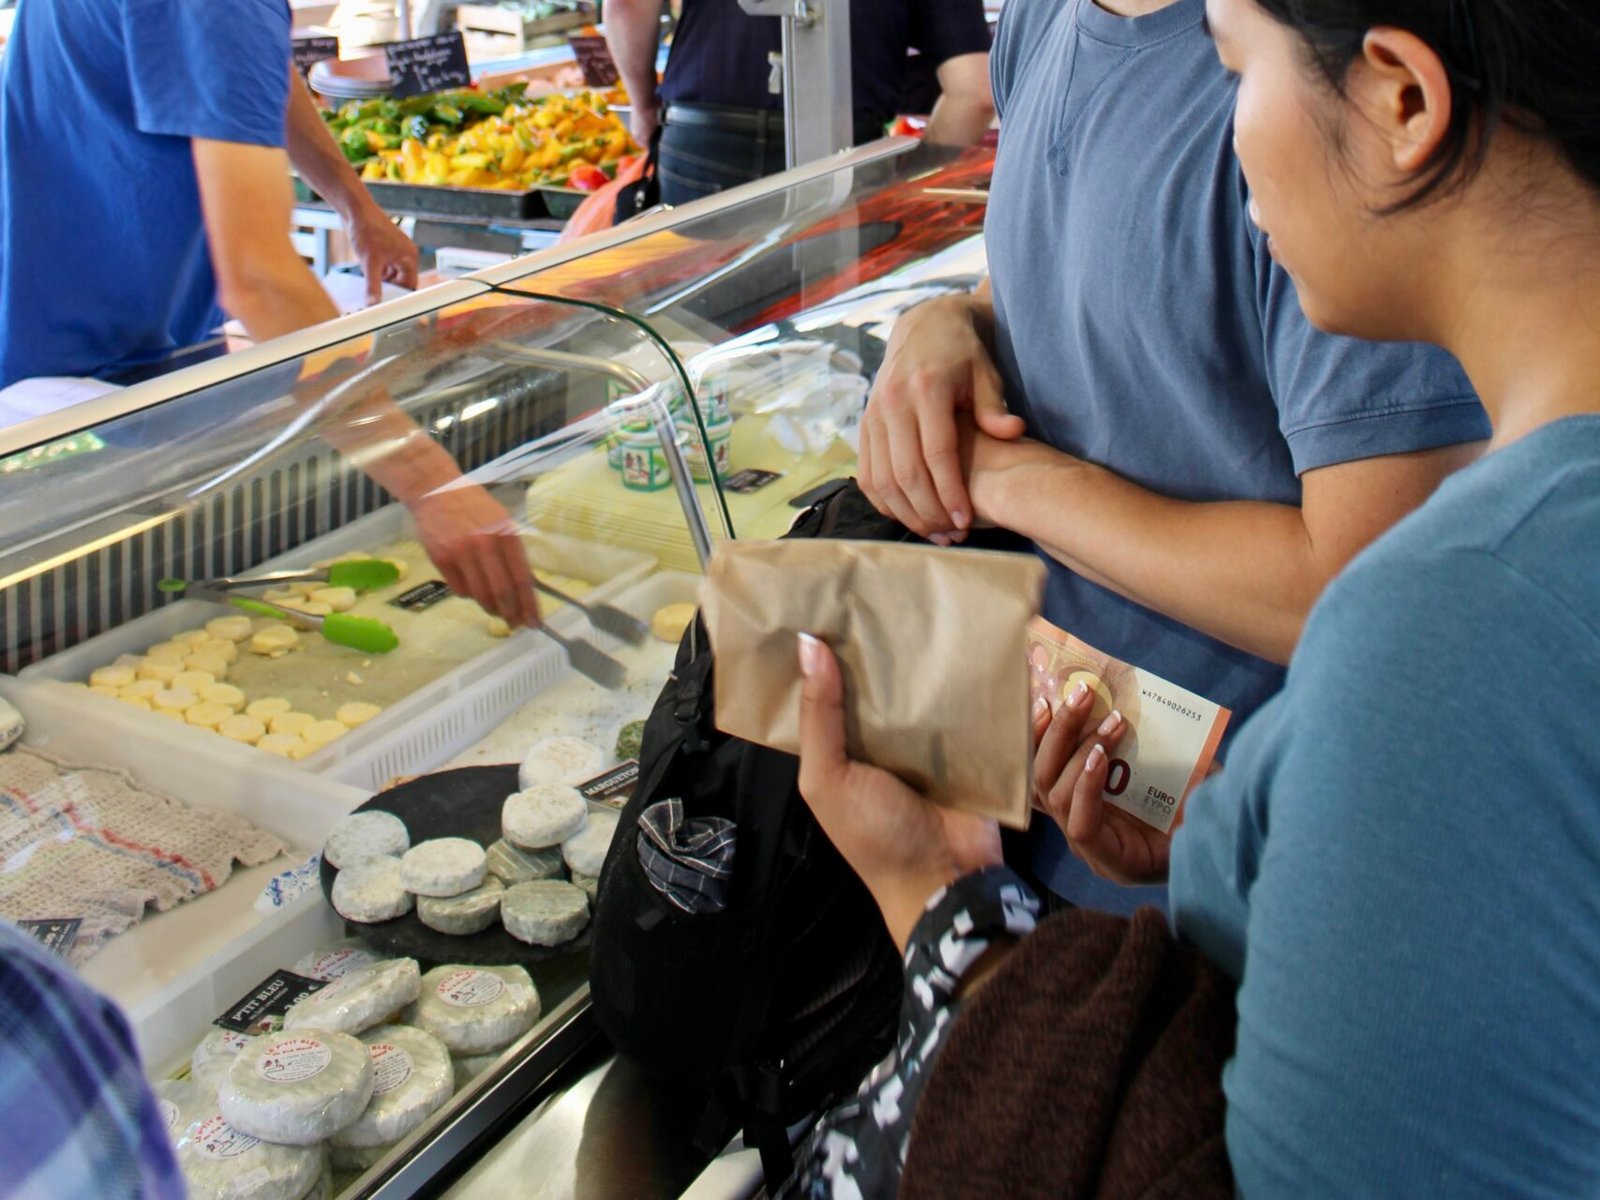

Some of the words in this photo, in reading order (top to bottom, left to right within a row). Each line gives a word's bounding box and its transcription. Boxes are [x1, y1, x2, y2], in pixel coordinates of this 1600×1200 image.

[1104, 758, 1131, 796] 0
[1147, 785, 1176, 806] EURO
[231, 999, 260, 1022] P'TIT
[256, 978, 286, 1002] BLEU
